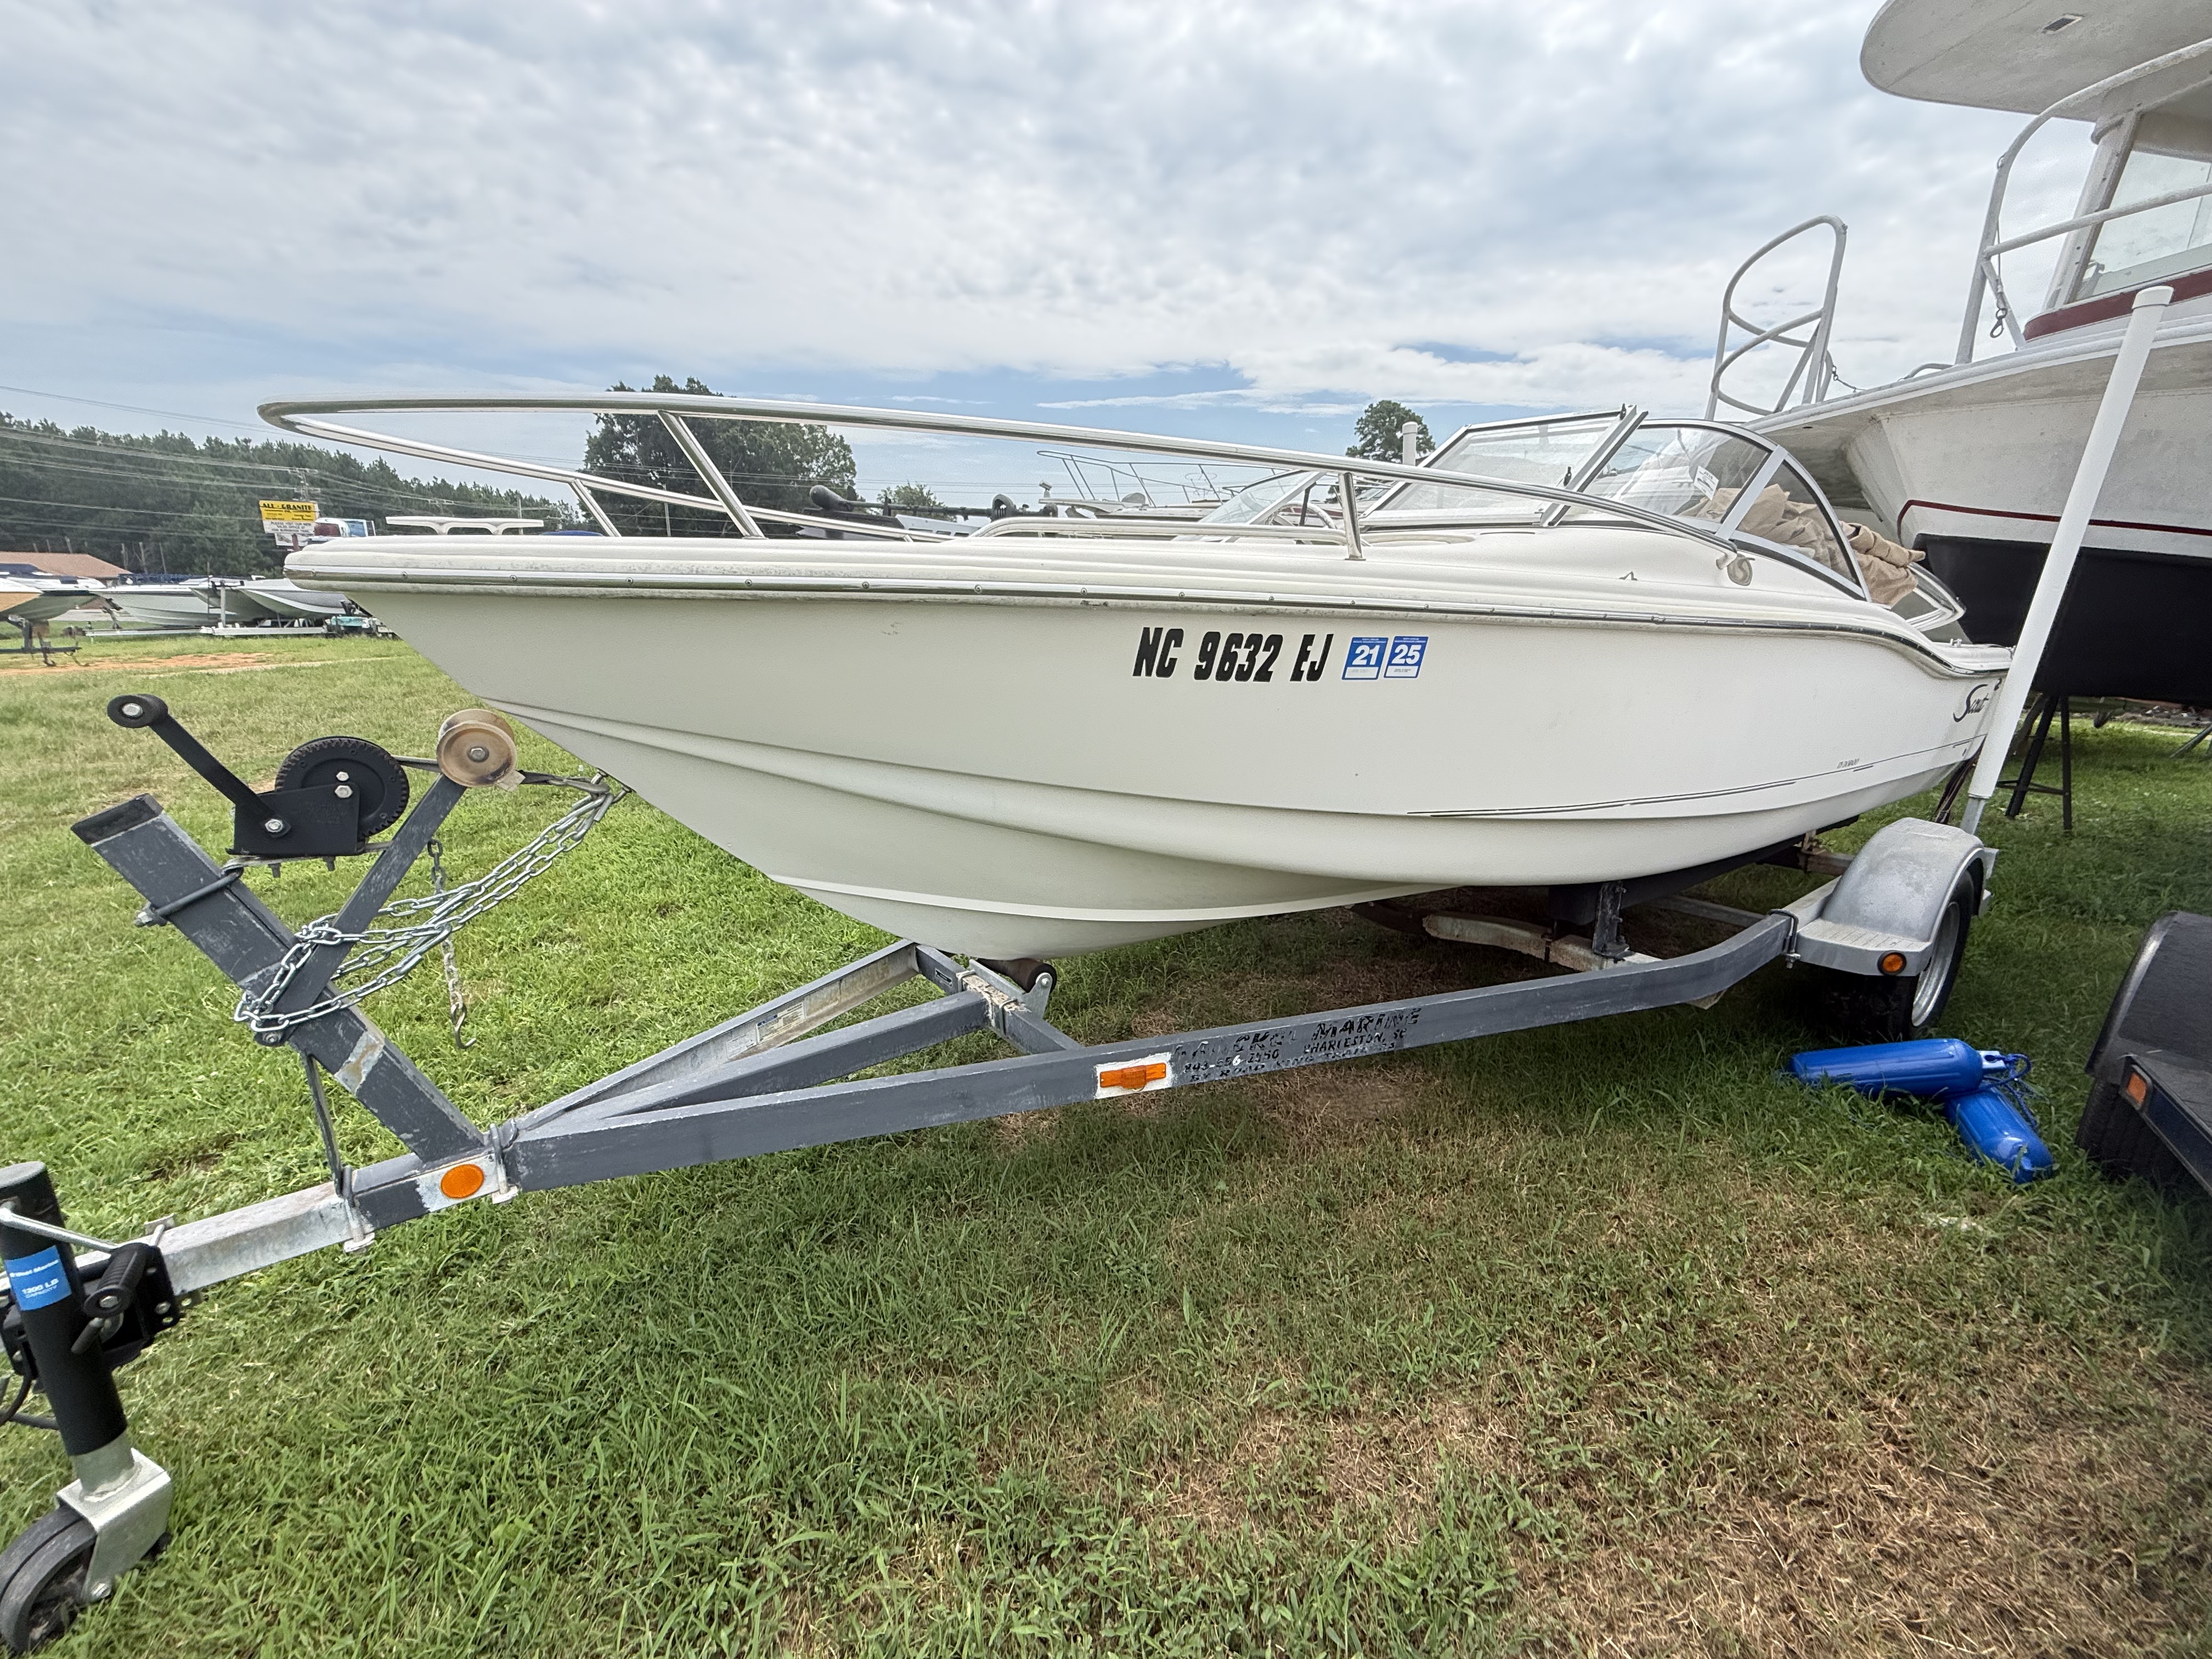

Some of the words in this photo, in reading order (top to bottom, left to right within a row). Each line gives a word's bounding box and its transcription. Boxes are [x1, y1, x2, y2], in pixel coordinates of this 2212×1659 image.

[1133, 627, 1184, 678] NC
[1194, 632, 1283, 682] 9632
[1289, 634, 1334, 682] EJ
[1352, 645, 1380, 665] 21
[1391, 644, 1420, 665] 25
[1311, 1008, 1421, 1041] MARINE
[22, 1284, 43, 1294] 1200
[44, 1278, 59, 1288] LB
[25, 1285, 58, 1299] CAPACITY
